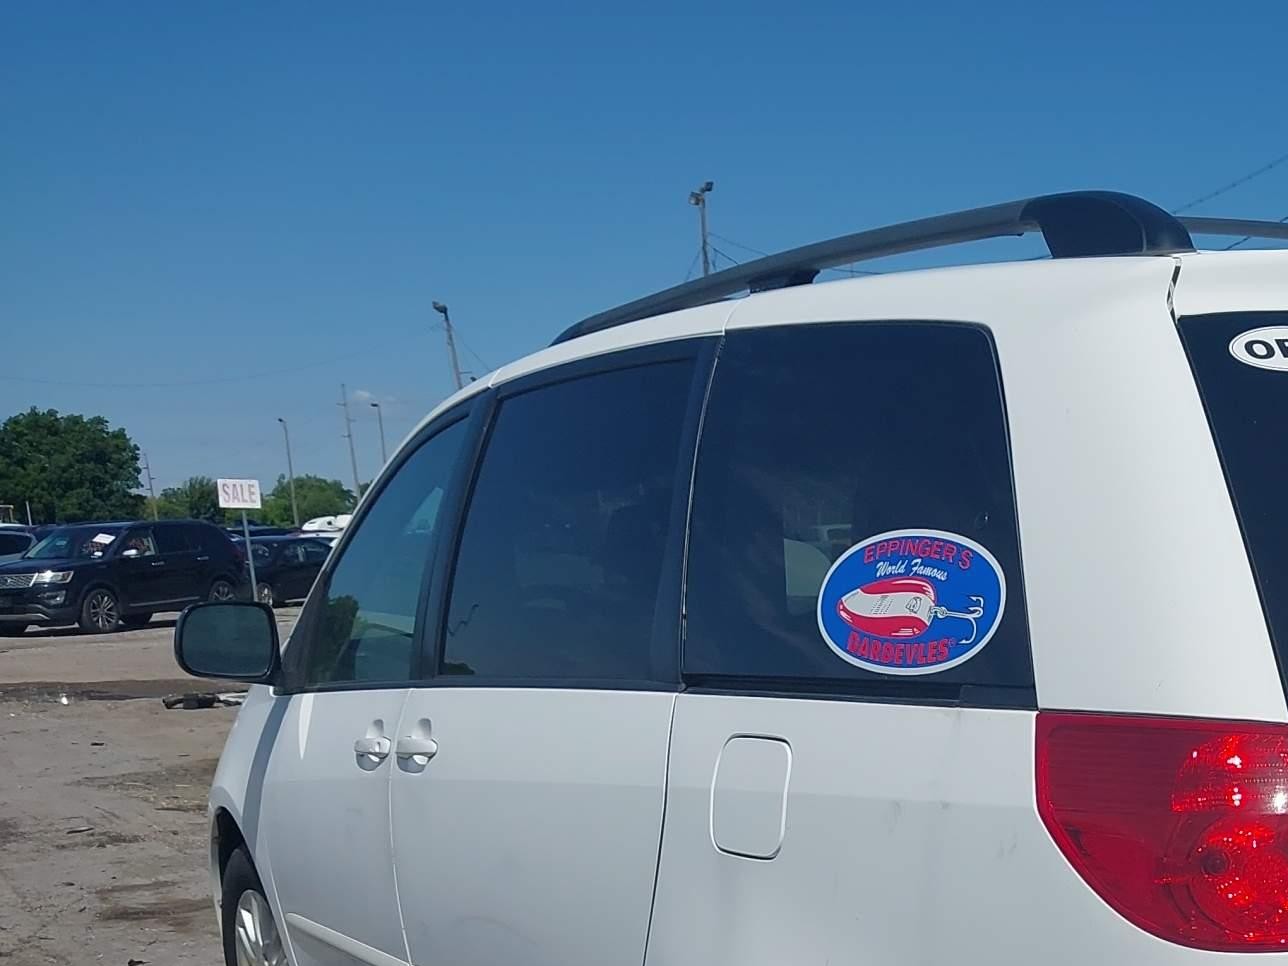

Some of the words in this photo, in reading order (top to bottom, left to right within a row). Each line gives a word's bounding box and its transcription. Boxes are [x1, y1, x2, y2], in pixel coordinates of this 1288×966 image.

[222, 483, 257, 504] SALE
[863, 539, 974, 570] EPPINGER'S
[875, 560, 908, 578] World
[909, 559, 949, 581] Famous
